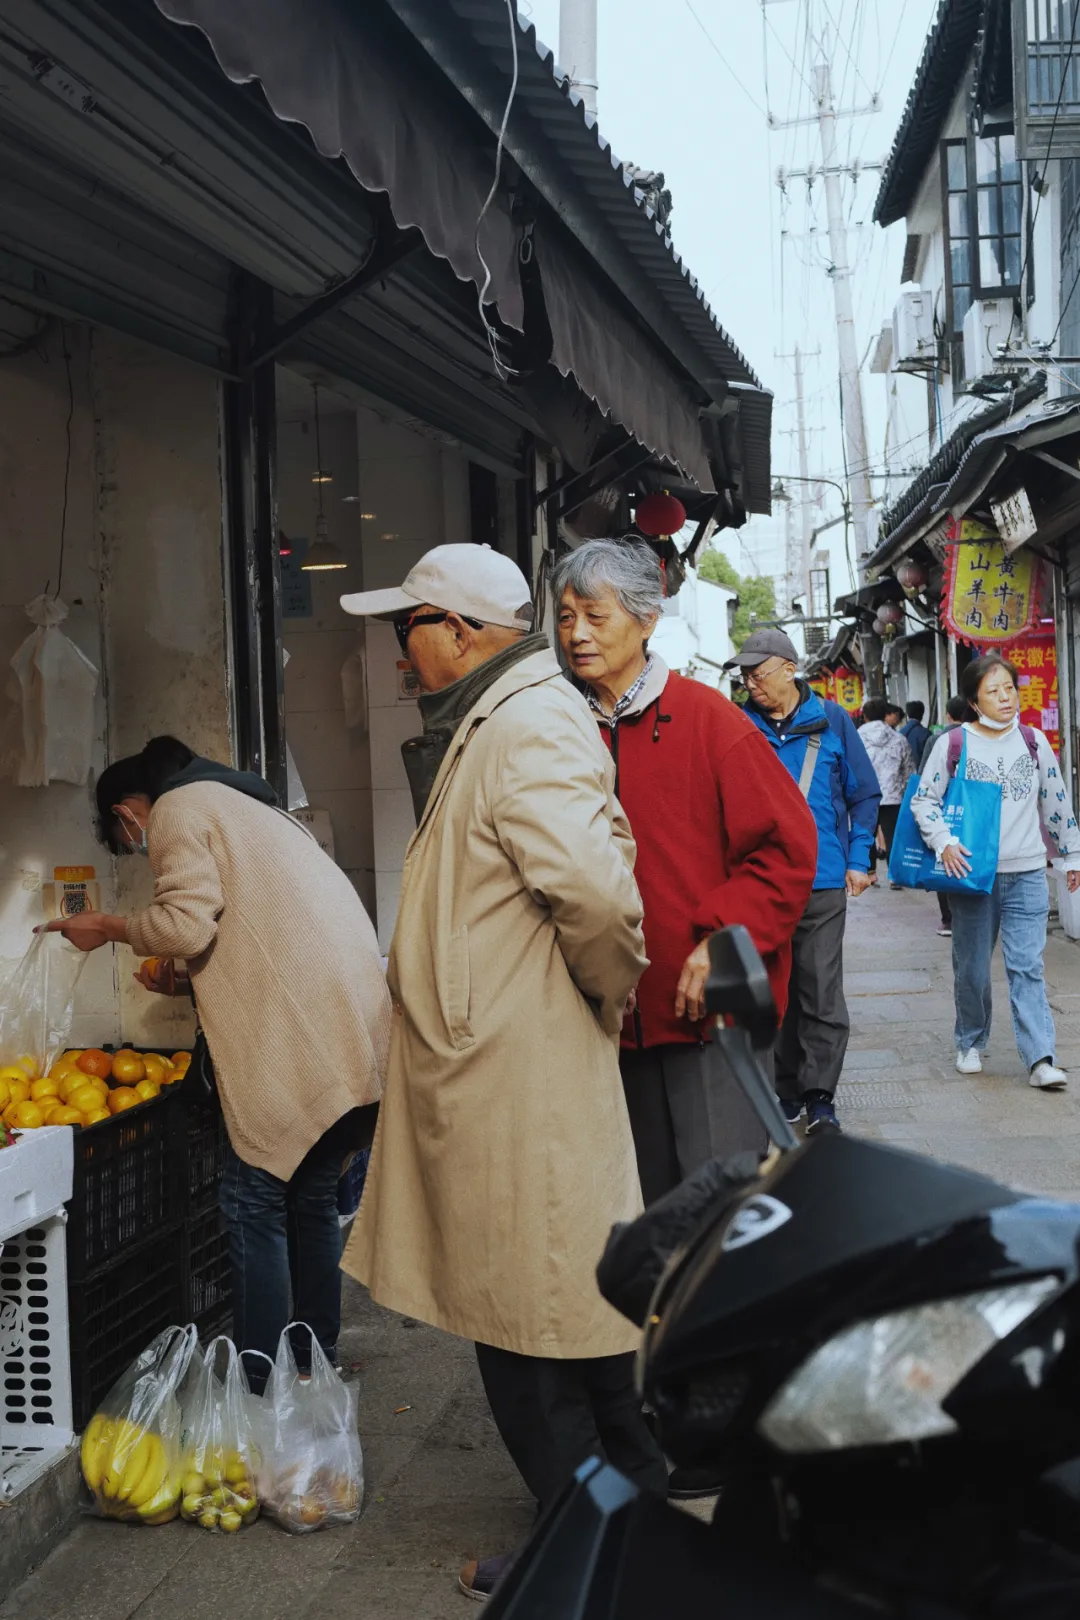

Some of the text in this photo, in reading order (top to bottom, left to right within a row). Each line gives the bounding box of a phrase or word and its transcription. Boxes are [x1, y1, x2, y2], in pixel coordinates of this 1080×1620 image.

[965, 553, 991, 629] 山羊肉
[994, 556, 1018, 631] 黄牛肉
